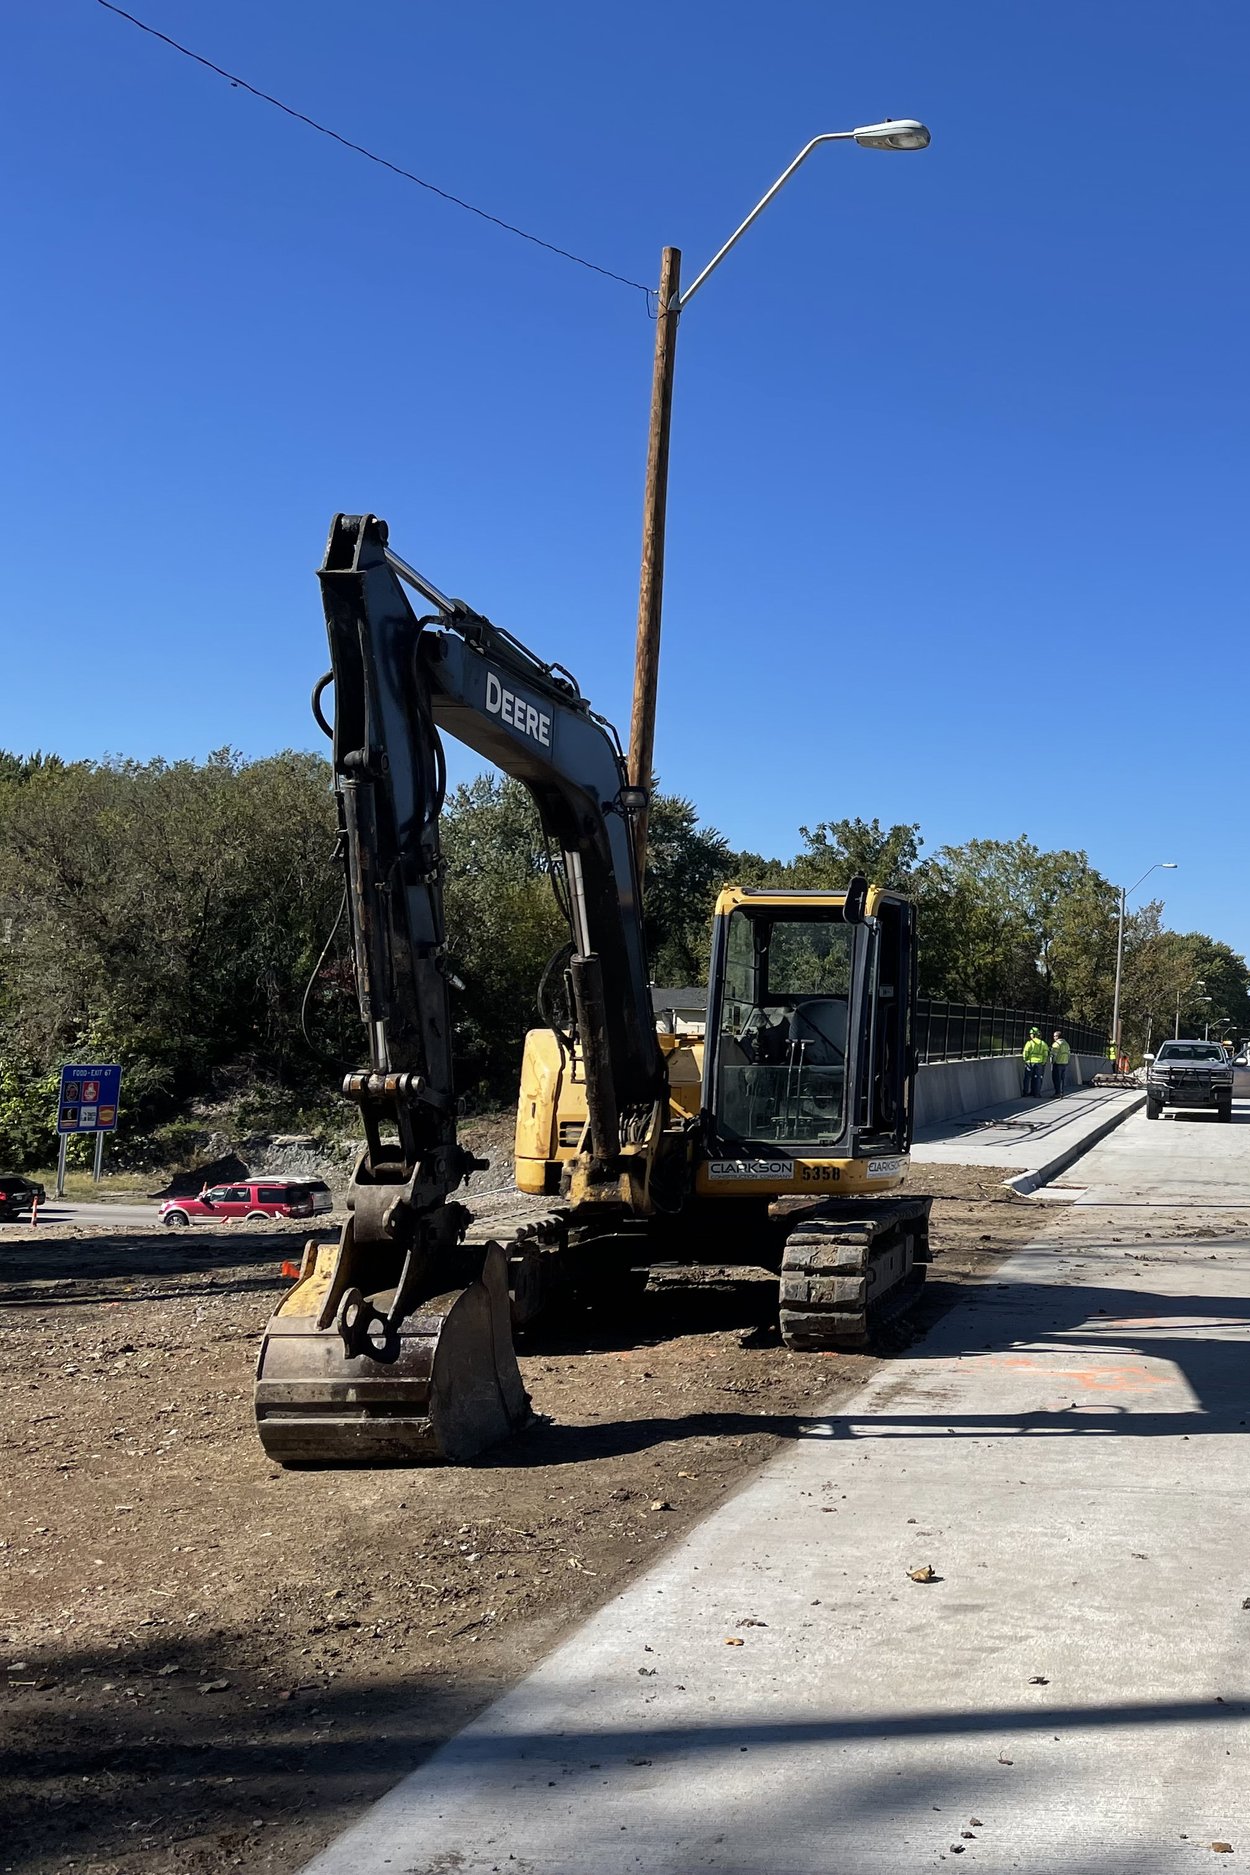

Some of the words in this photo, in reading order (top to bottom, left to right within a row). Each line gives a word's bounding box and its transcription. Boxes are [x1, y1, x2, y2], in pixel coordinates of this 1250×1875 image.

[485, 671, 551, 747] DEERE
[710, 1162, 793, 1174] CLARKSON
[802, 1166, 840, 1181] 5358
